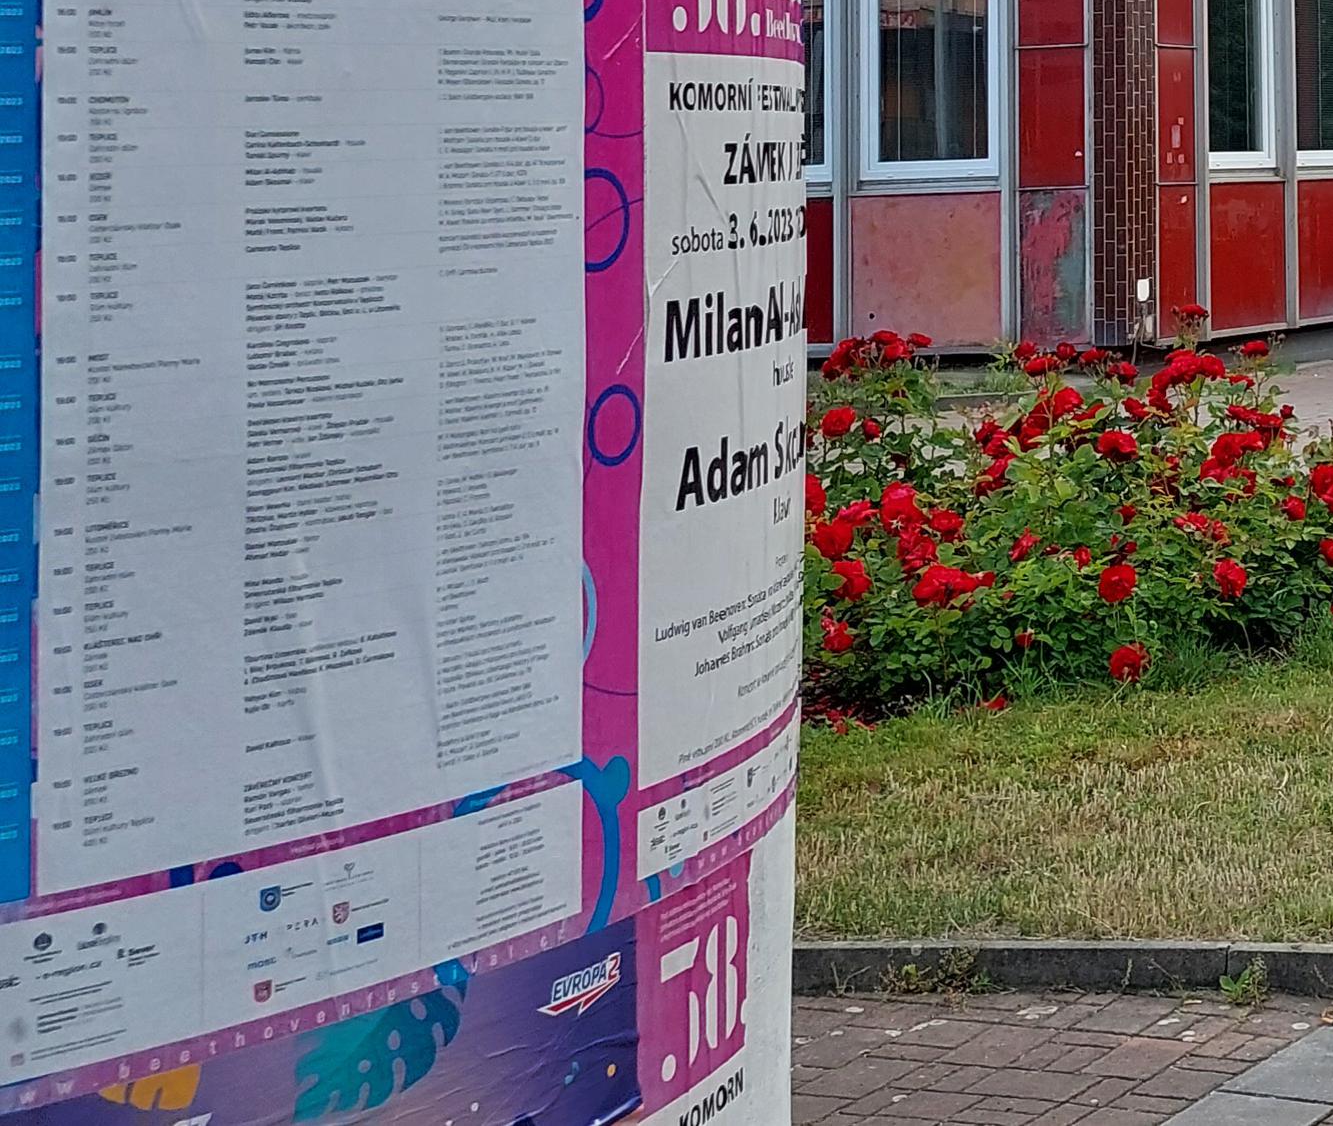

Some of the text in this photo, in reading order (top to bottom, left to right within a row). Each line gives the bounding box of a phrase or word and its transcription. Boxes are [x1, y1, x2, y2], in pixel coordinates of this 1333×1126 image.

[669, 78, 753, 111] KOMORNÍ
[671, 227, 724, 256] sobota
[728, 213, 745, 250] 3.
[750, 211, 766, 247] 6.
[664, 291, 763, 363] Milan
[675, 436, 769, 512] Adam
[655, 620, 690, 642] Ludwig
[692, 616, 707, 630] van
